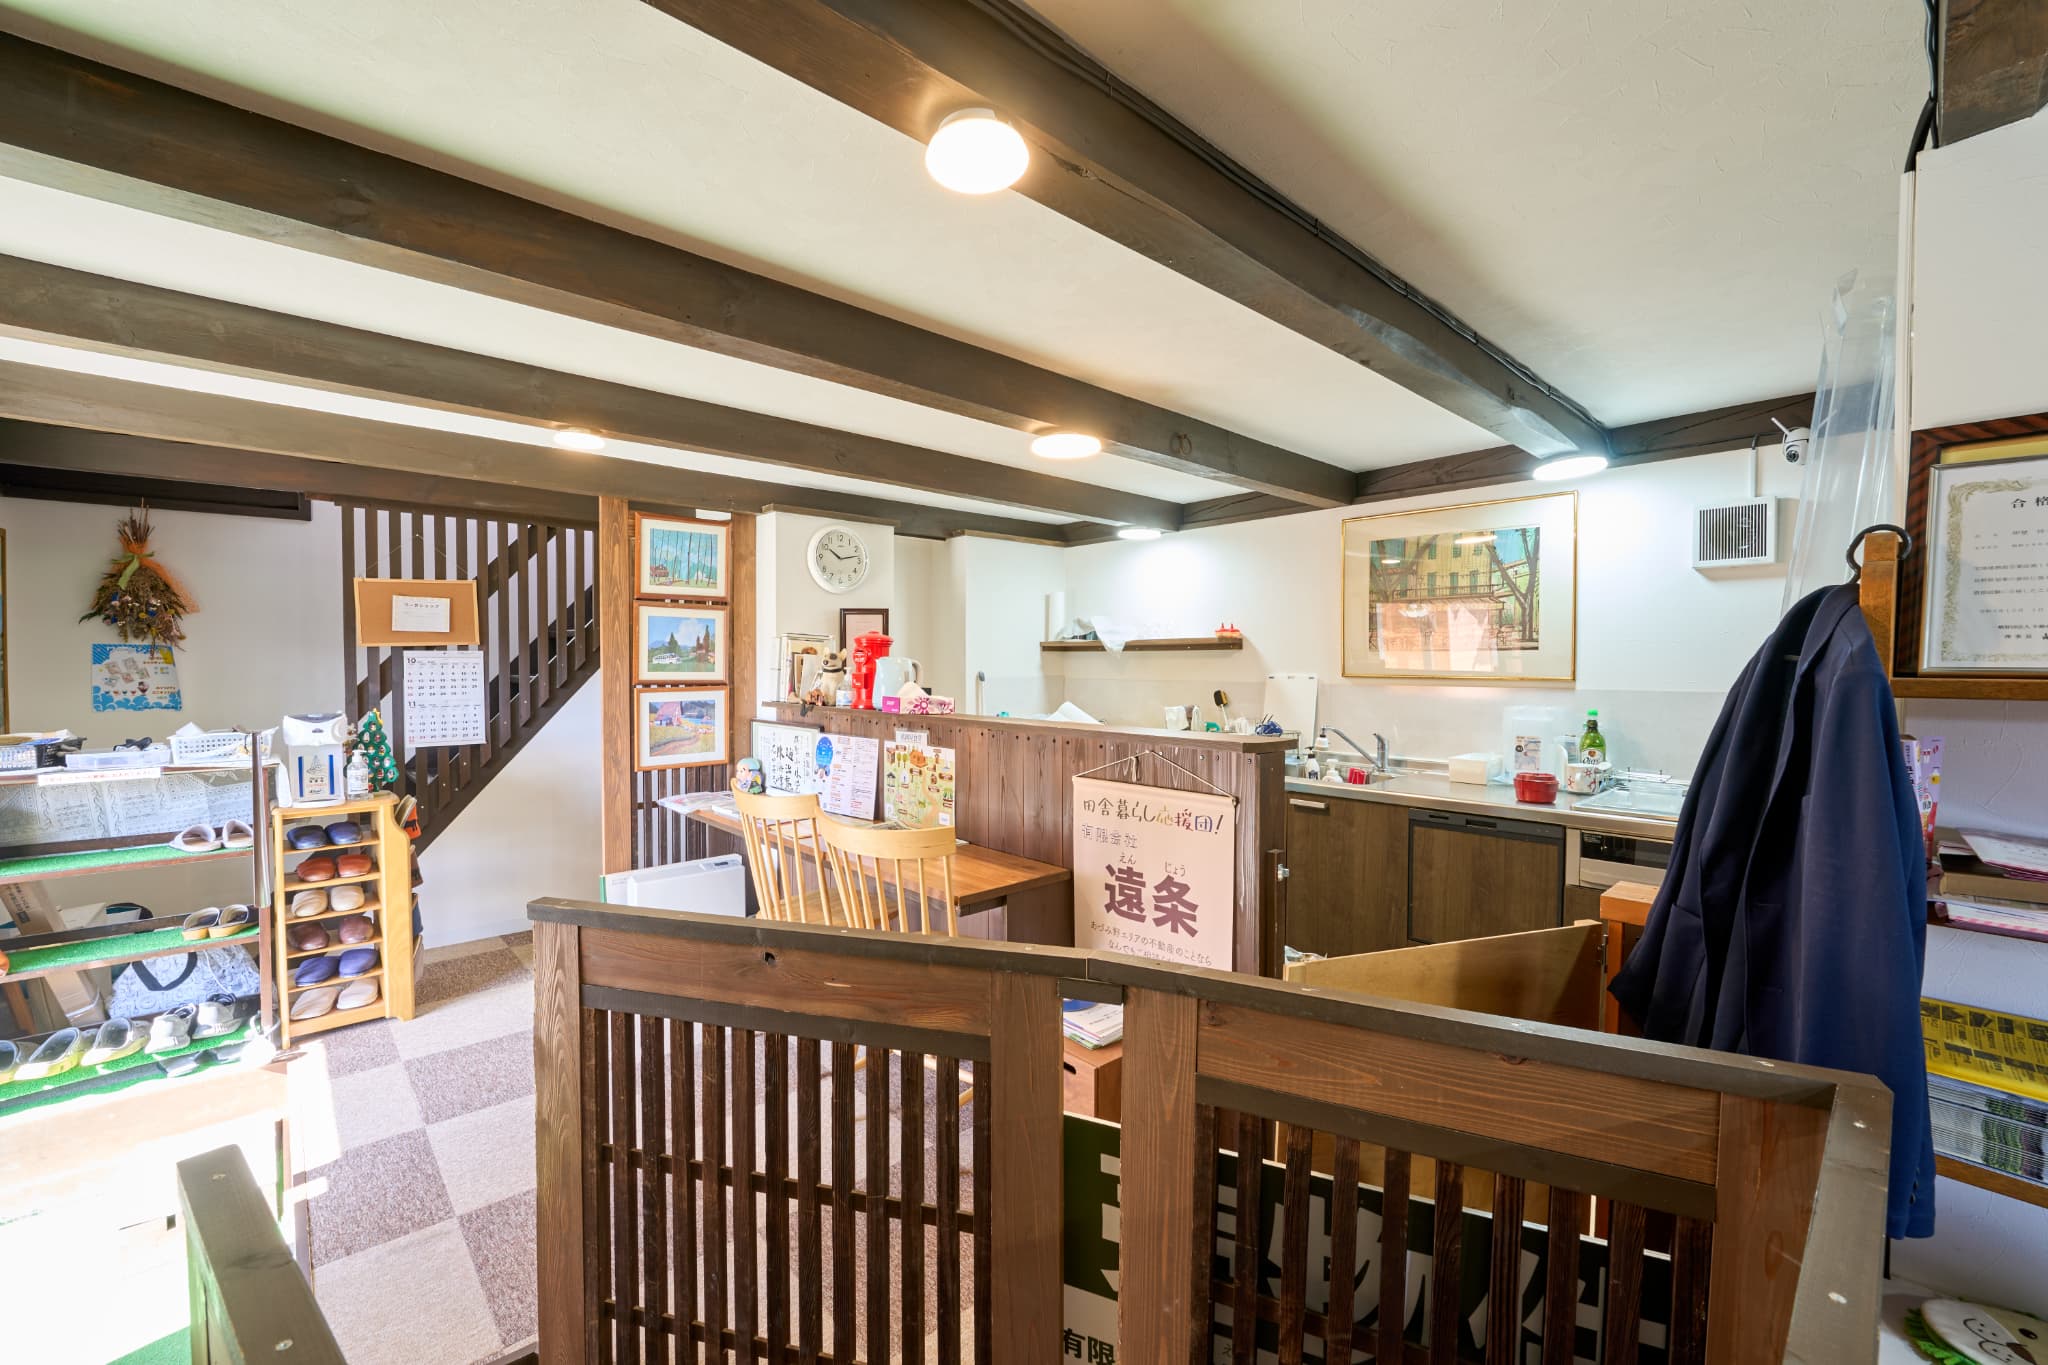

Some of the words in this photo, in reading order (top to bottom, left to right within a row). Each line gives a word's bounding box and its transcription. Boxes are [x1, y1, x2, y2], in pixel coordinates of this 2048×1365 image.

[1081, 823, 1138, 849] 有限会社
[1119, 852, 1137, 865] えん
[1164, 861, 1187, 877] じょう
[1104, 863, 1199, 938] 遠条
